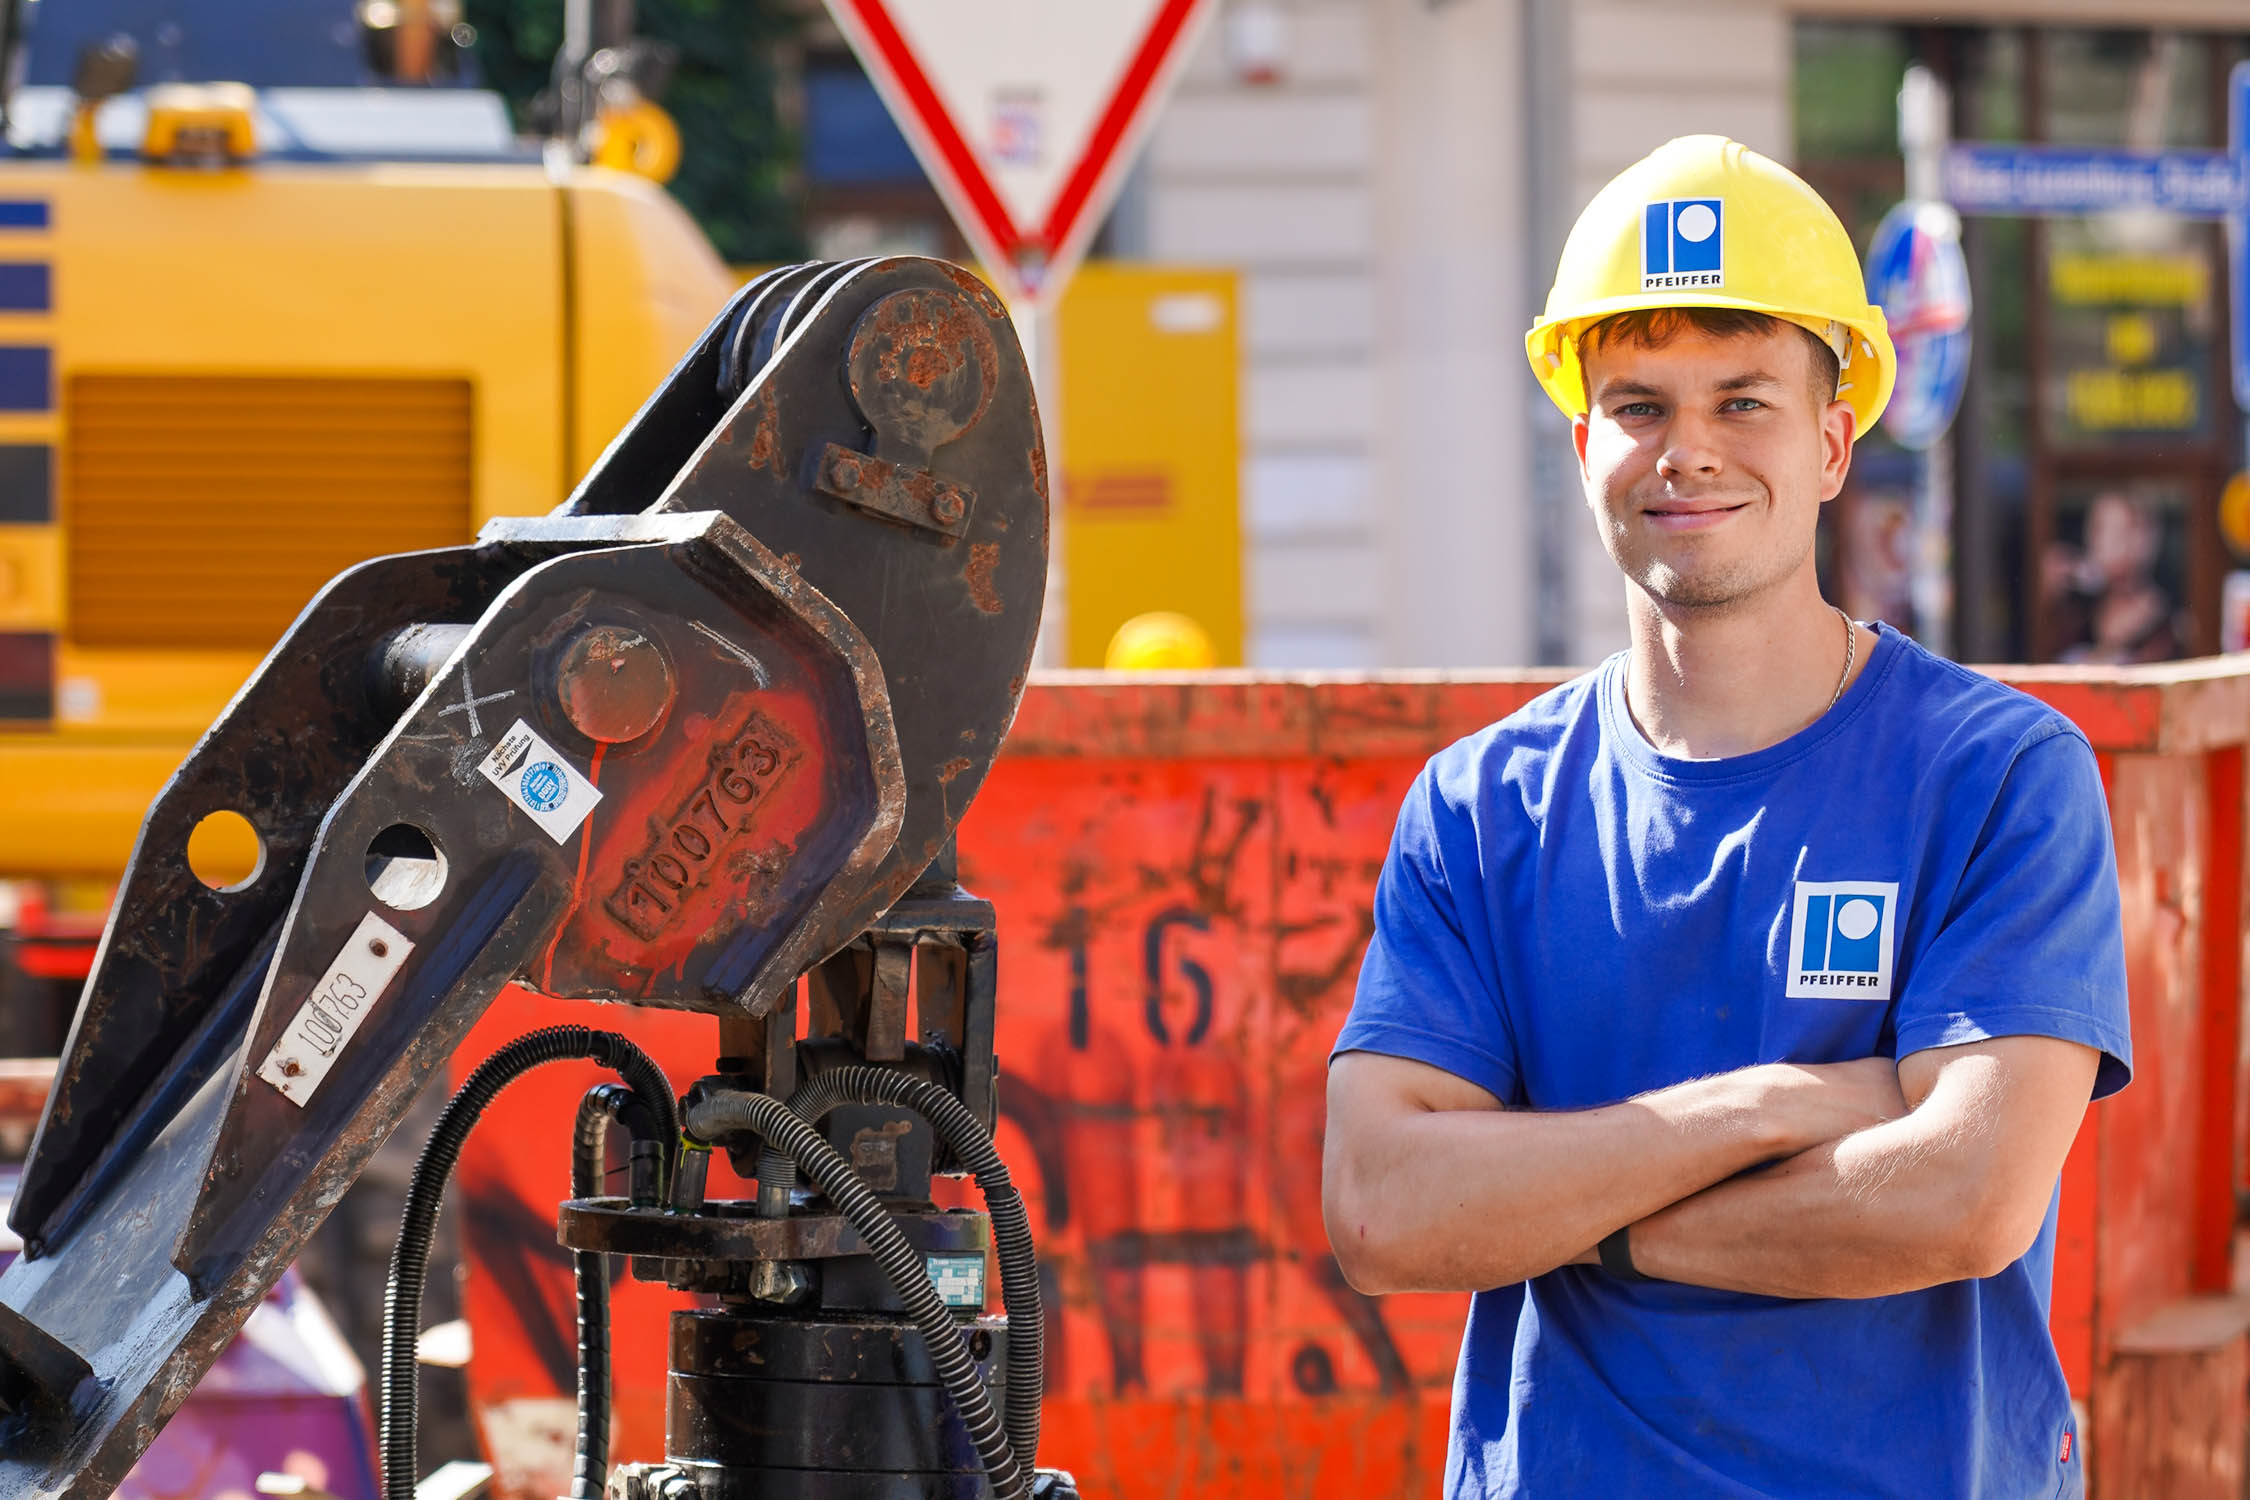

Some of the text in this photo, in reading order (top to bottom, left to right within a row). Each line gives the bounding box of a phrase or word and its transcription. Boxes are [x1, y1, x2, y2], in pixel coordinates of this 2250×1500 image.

[1646, 274, 1721, 288] PFEIFFER
[491, 735, 517, 762] Nächste
[492, 733, 531, 776] UVV Prüfung
[629, 738, 779, 913] 100763
[1800, 974, 1879, 987] PFEIFFER
[298, 972, 367, 1056] 100763
